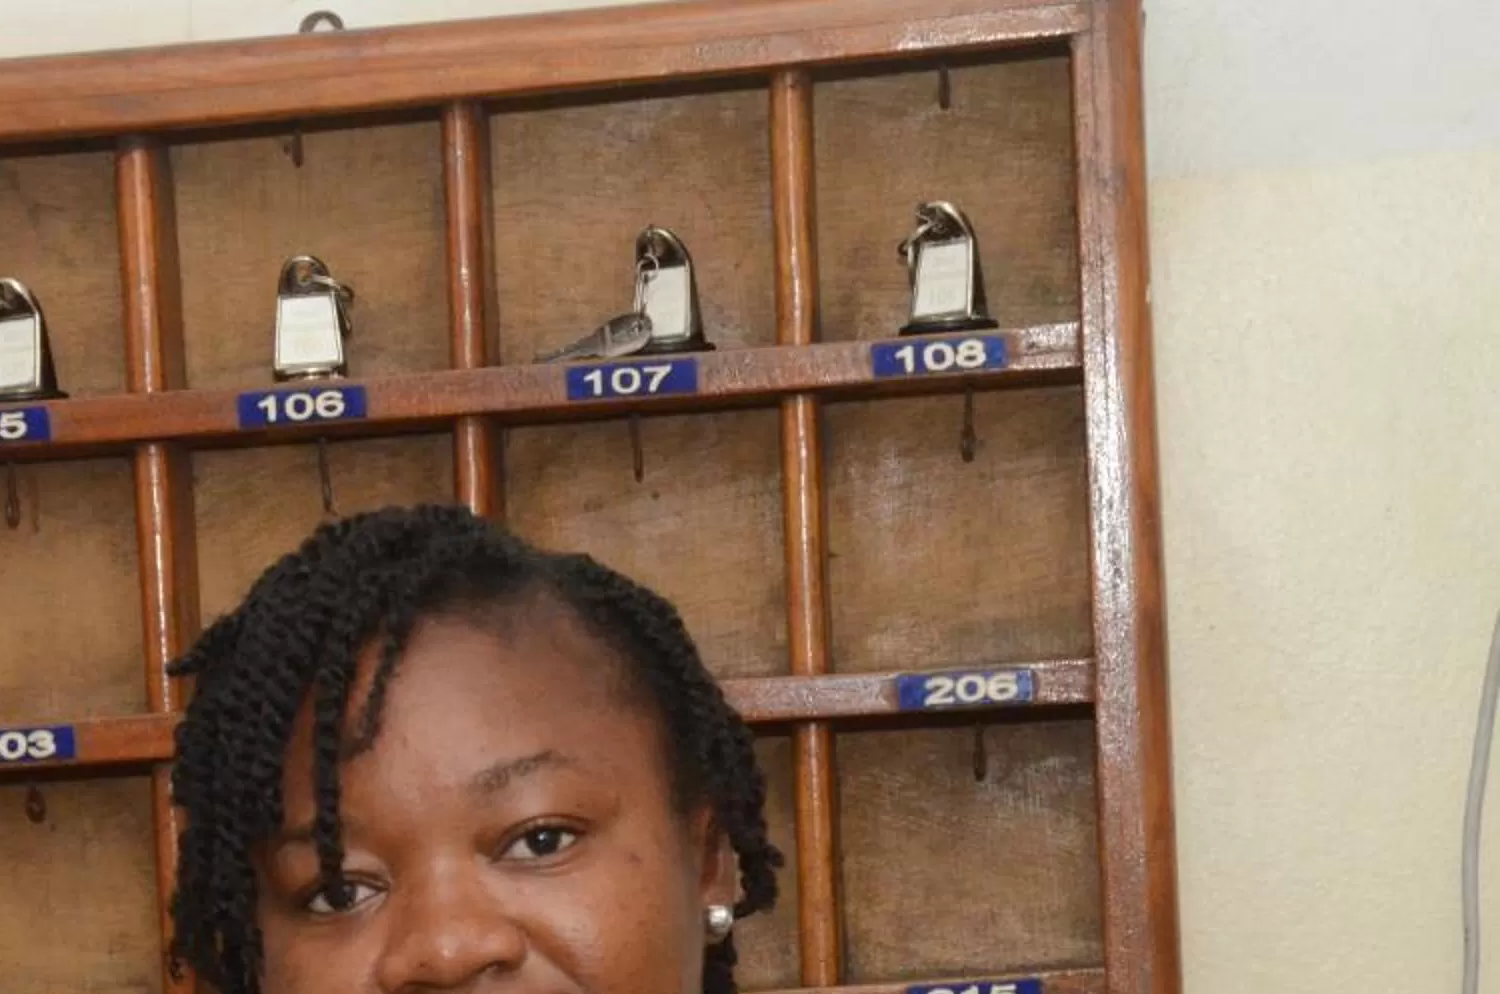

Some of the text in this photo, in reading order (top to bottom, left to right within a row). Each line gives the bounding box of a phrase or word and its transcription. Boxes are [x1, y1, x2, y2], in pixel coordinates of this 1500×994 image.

[895, 338, 987, 373] 108
[583, 364, 672, 395] 107
[258, 390, 345, 422] 106
[924, 672, 1019, 706] 206
